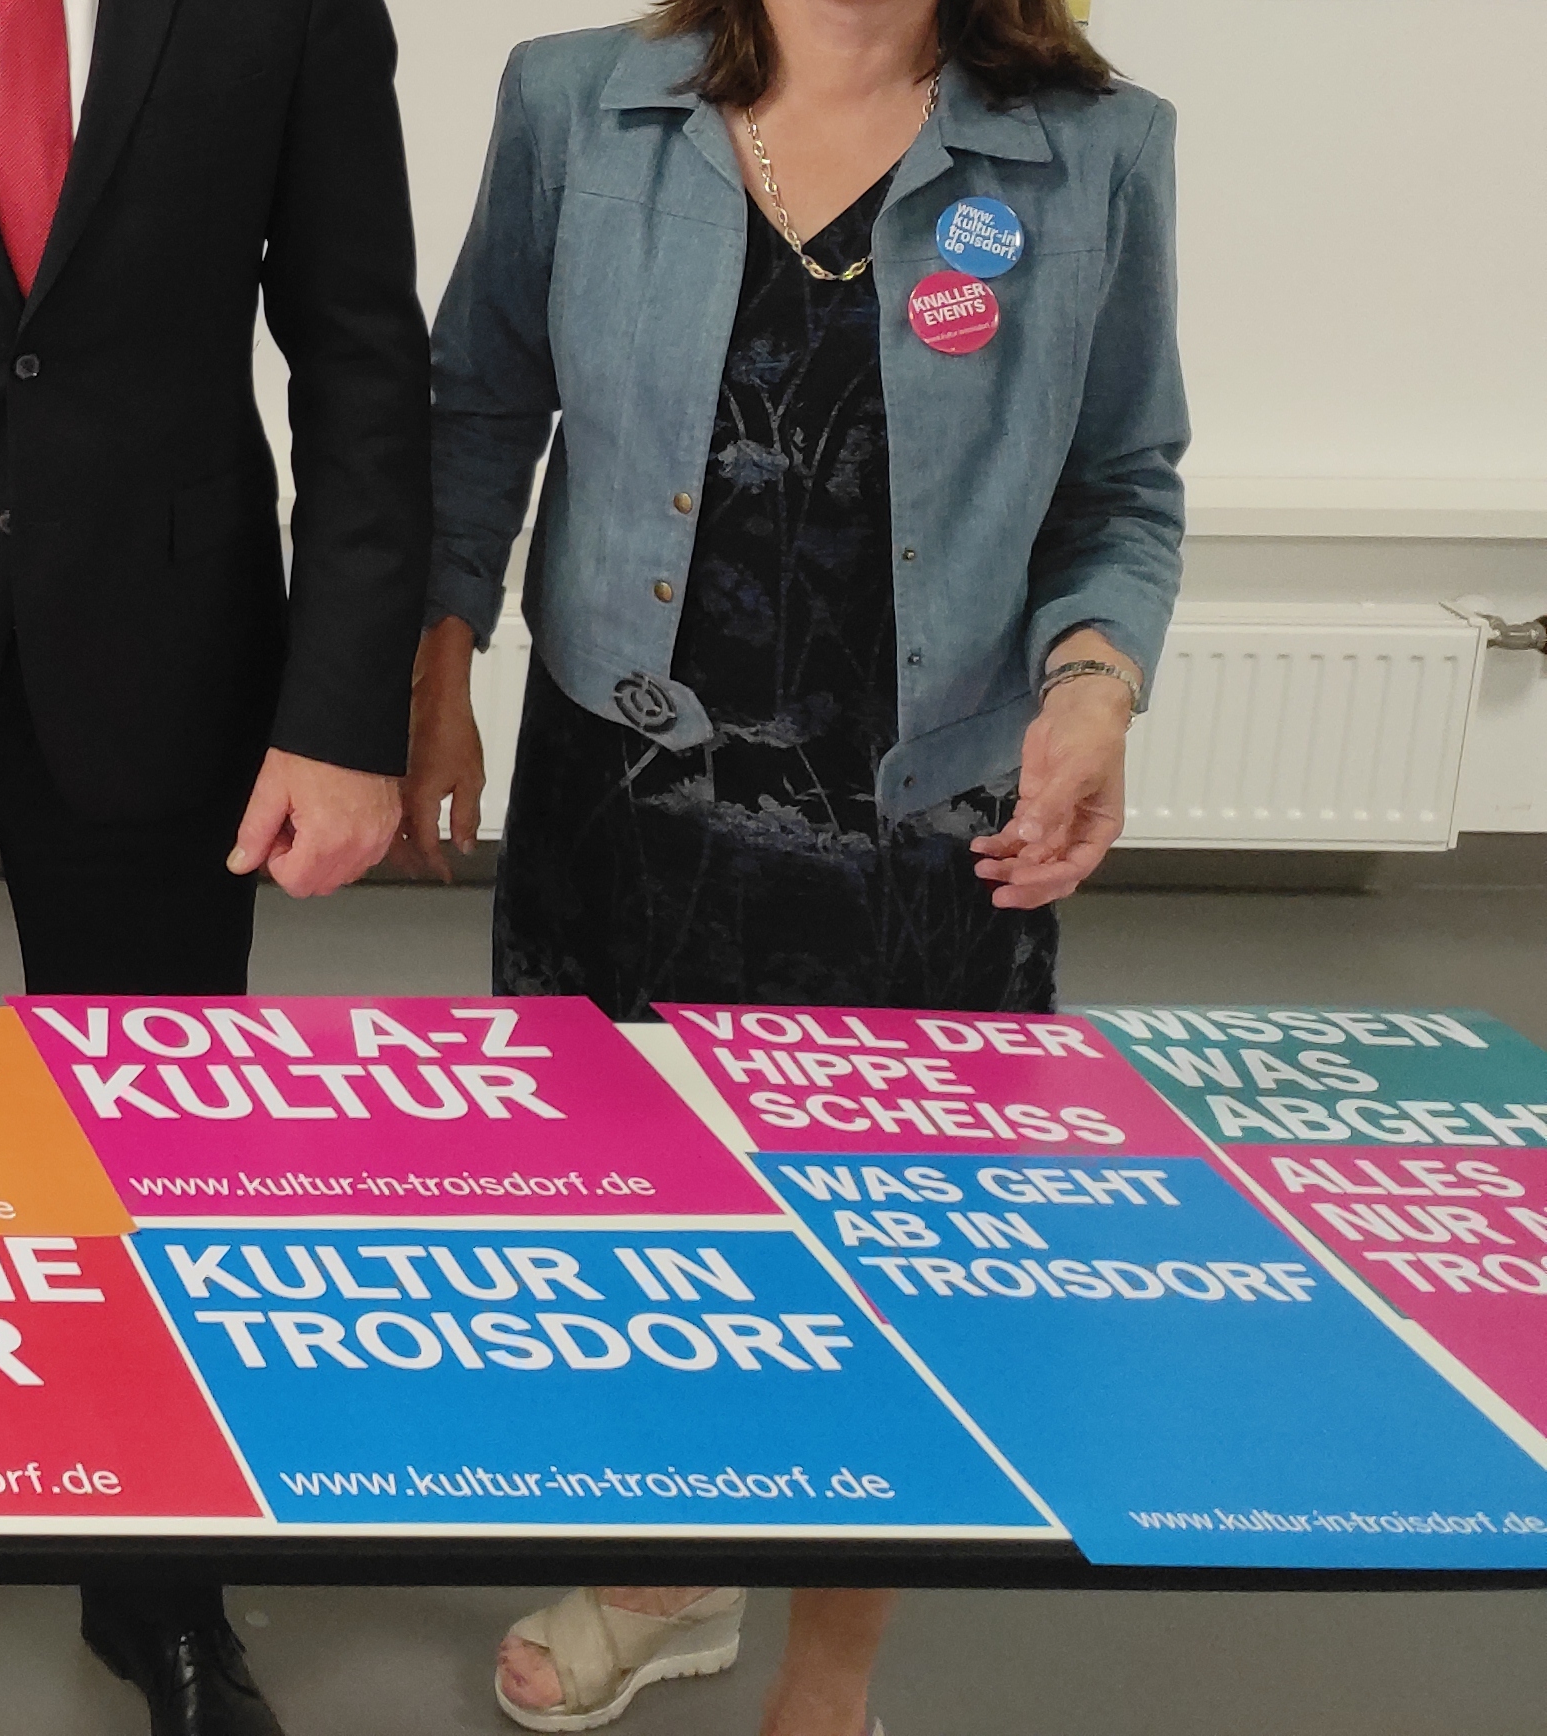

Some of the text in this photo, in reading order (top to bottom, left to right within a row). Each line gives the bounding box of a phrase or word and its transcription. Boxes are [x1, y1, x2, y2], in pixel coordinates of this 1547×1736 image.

[944, 236, 964, 254] de
[912, 282, 986, 313] KNALLER
[923, 299, 986, 326] EVENTS
[32, 1008, 552, 1057] VON A-Z
[679, 1011, 1103, 1058] VOLL DER
[1085, 1008, 1488, 1047] WISSEN
[722, 1048, 974, 1093] HIPPE
[1132, 1046, 1379, 1092] WAS
[72, 1065, 565, 1119] KULTUR
[755, 1092, 1125, 1145] SCHEISS
[130, 1172, 655, 1195] www.kultur-in-troisdorf.de
[779, 1166, 1180, 1205] WAS GEHT
[1271, 1157, 1525, 1197] ALLES
[834, 1210, 1048, 1249] AB IN
[1311, 1203, 1515, 1244] NUR
[165, 1245, 755, 1300] KULTUR IN
[860, 1257, 1316, 1301] TROISDORF
[1363, 1252, 1547, 1294] TRO
[195, 1311, 853, 1370] TROISDORF
[280, 1466, 895, 1498] www.kultur-in-troisdorf.de
[1129, 1509, 1547, 1533] www.kultur-in-troisdorf.de
